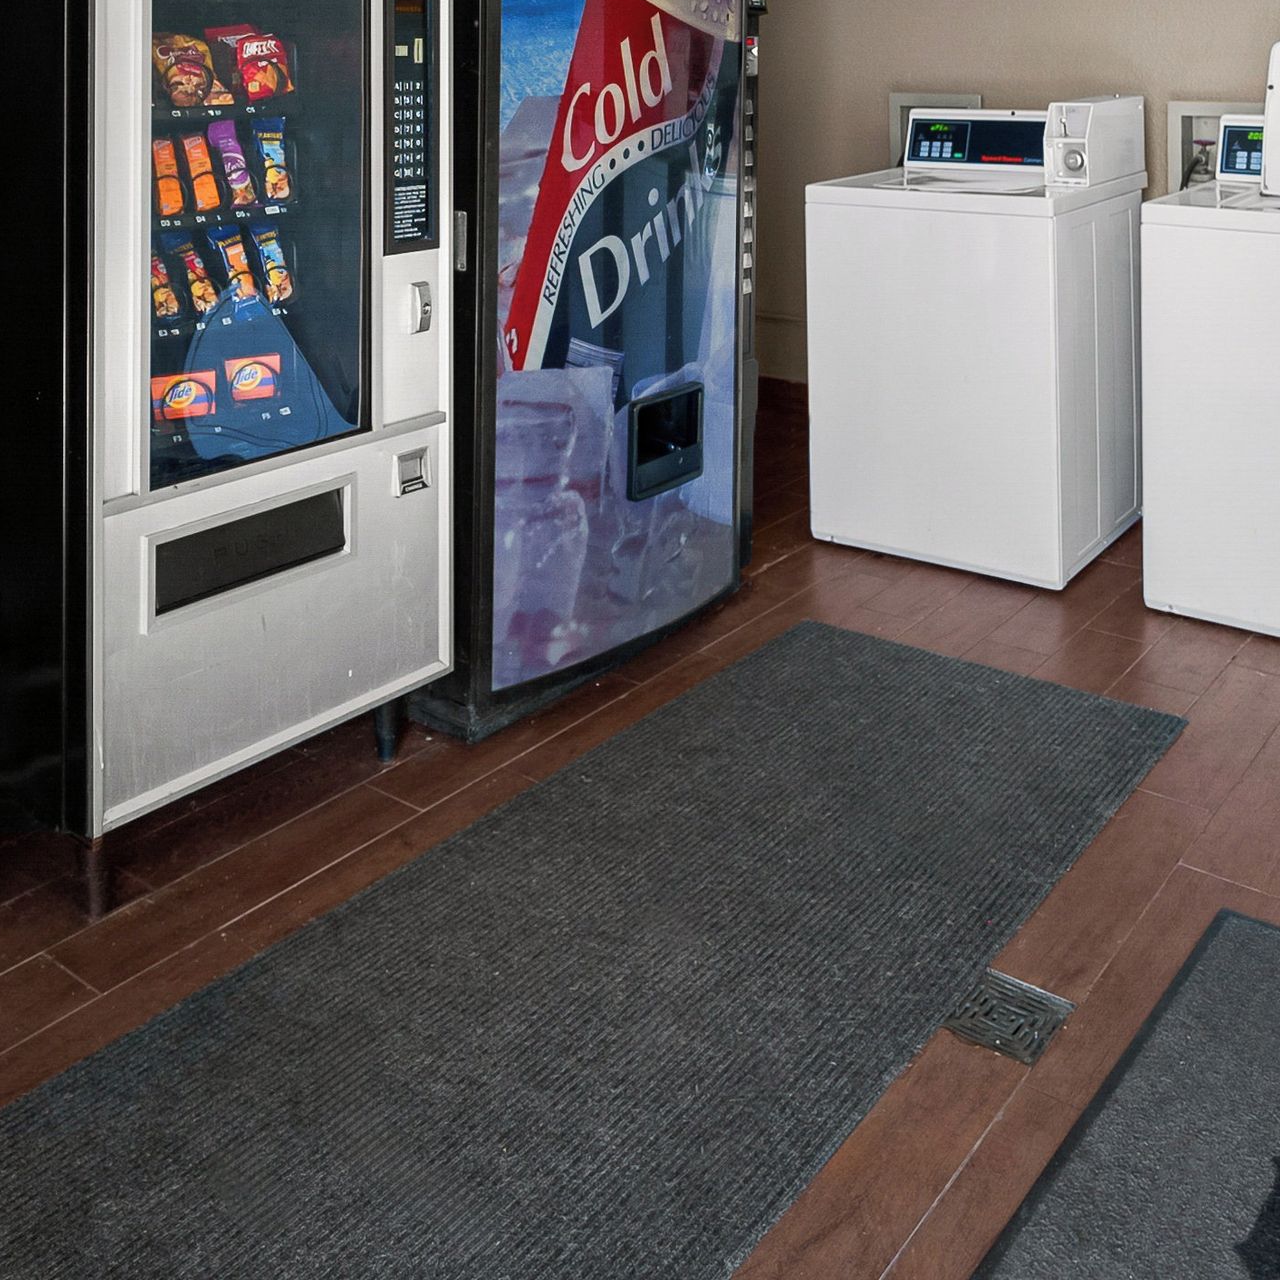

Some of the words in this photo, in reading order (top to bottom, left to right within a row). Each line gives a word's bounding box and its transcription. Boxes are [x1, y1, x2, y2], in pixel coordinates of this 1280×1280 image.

[560, 11, 673, 173] Cold
[542, 163, 606, 306] REFRESHING
[650, 72, 715, 151] DELICIOUS
[169, 385, 193, 403] Tide
[233, 369, 259, 386] Tide
